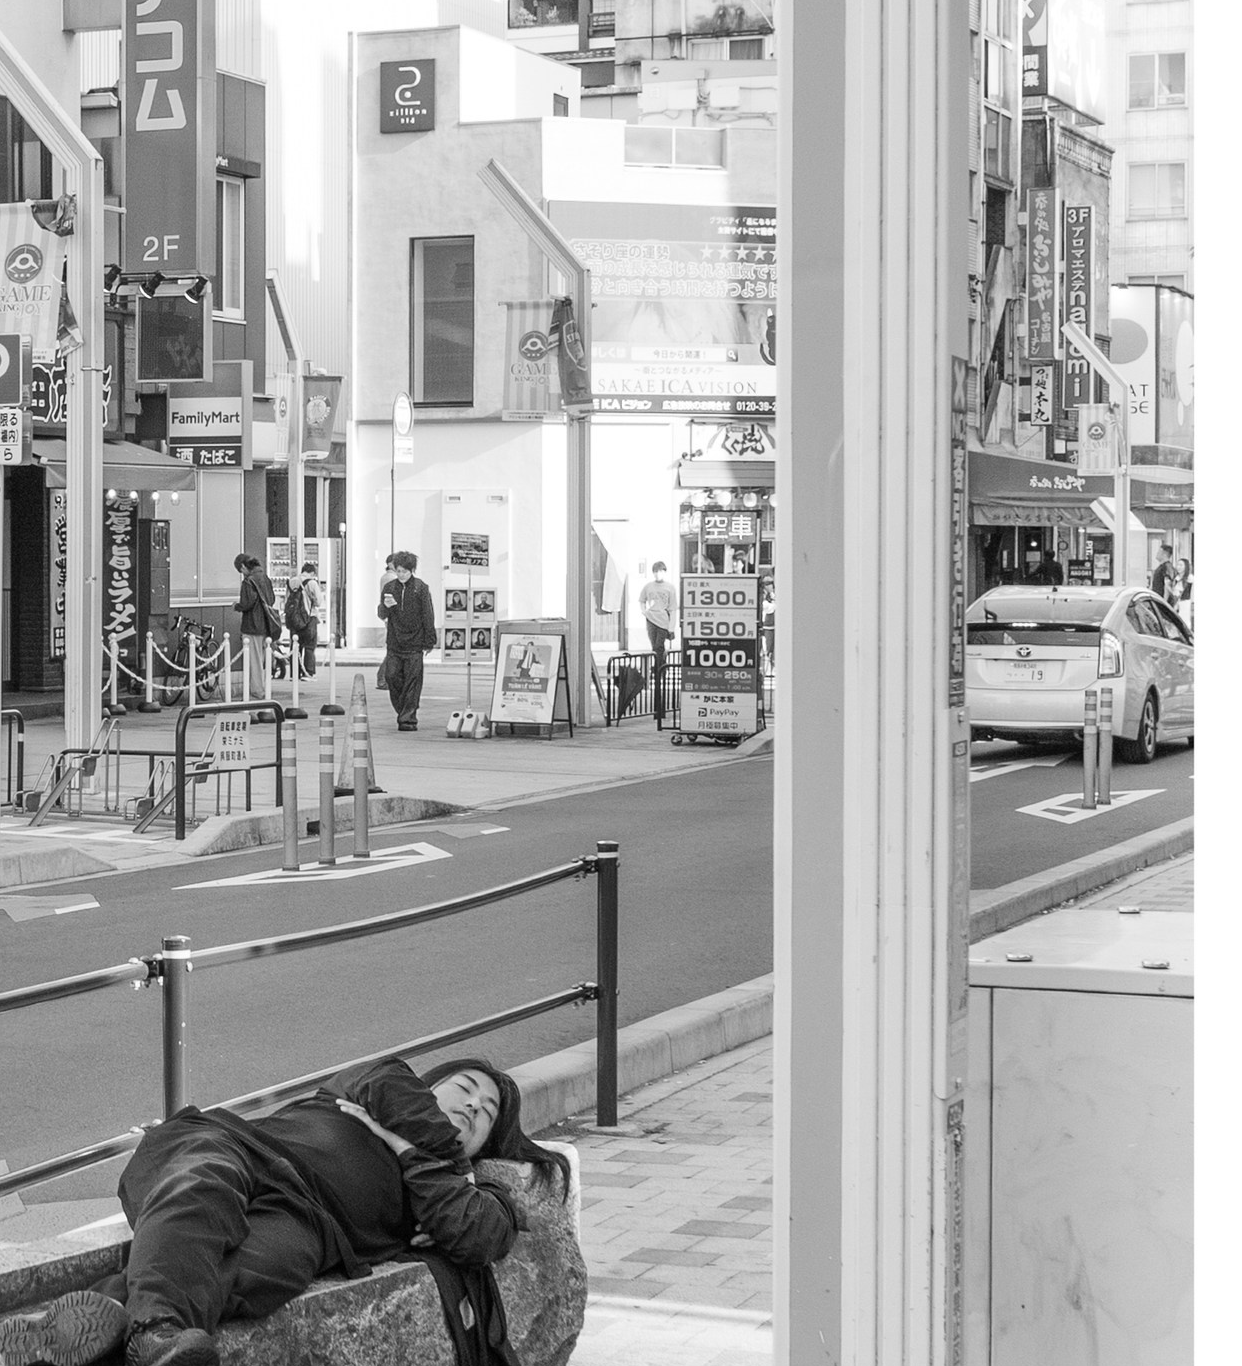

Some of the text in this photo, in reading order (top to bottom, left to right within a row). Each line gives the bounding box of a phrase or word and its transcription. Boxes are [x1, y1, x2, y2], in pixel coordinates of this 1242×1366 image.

[1068, 208, 1089, 223] 3F
[143, 235, 179, 261] 2F
[1071, 226, 1085, 291] アロマエステ
[19, 303, 45, 316] JOY
[1067, 290, 1089, 397] naomi
[598, 378, 757, 394] SAKAE ICA VISION
[172, 412, 240, 425] FamilyMart
[200, 449, 236, 465] たばこ
[704, 514, 754, 539] 空車
[710, 708, 739, 717] PayPay
